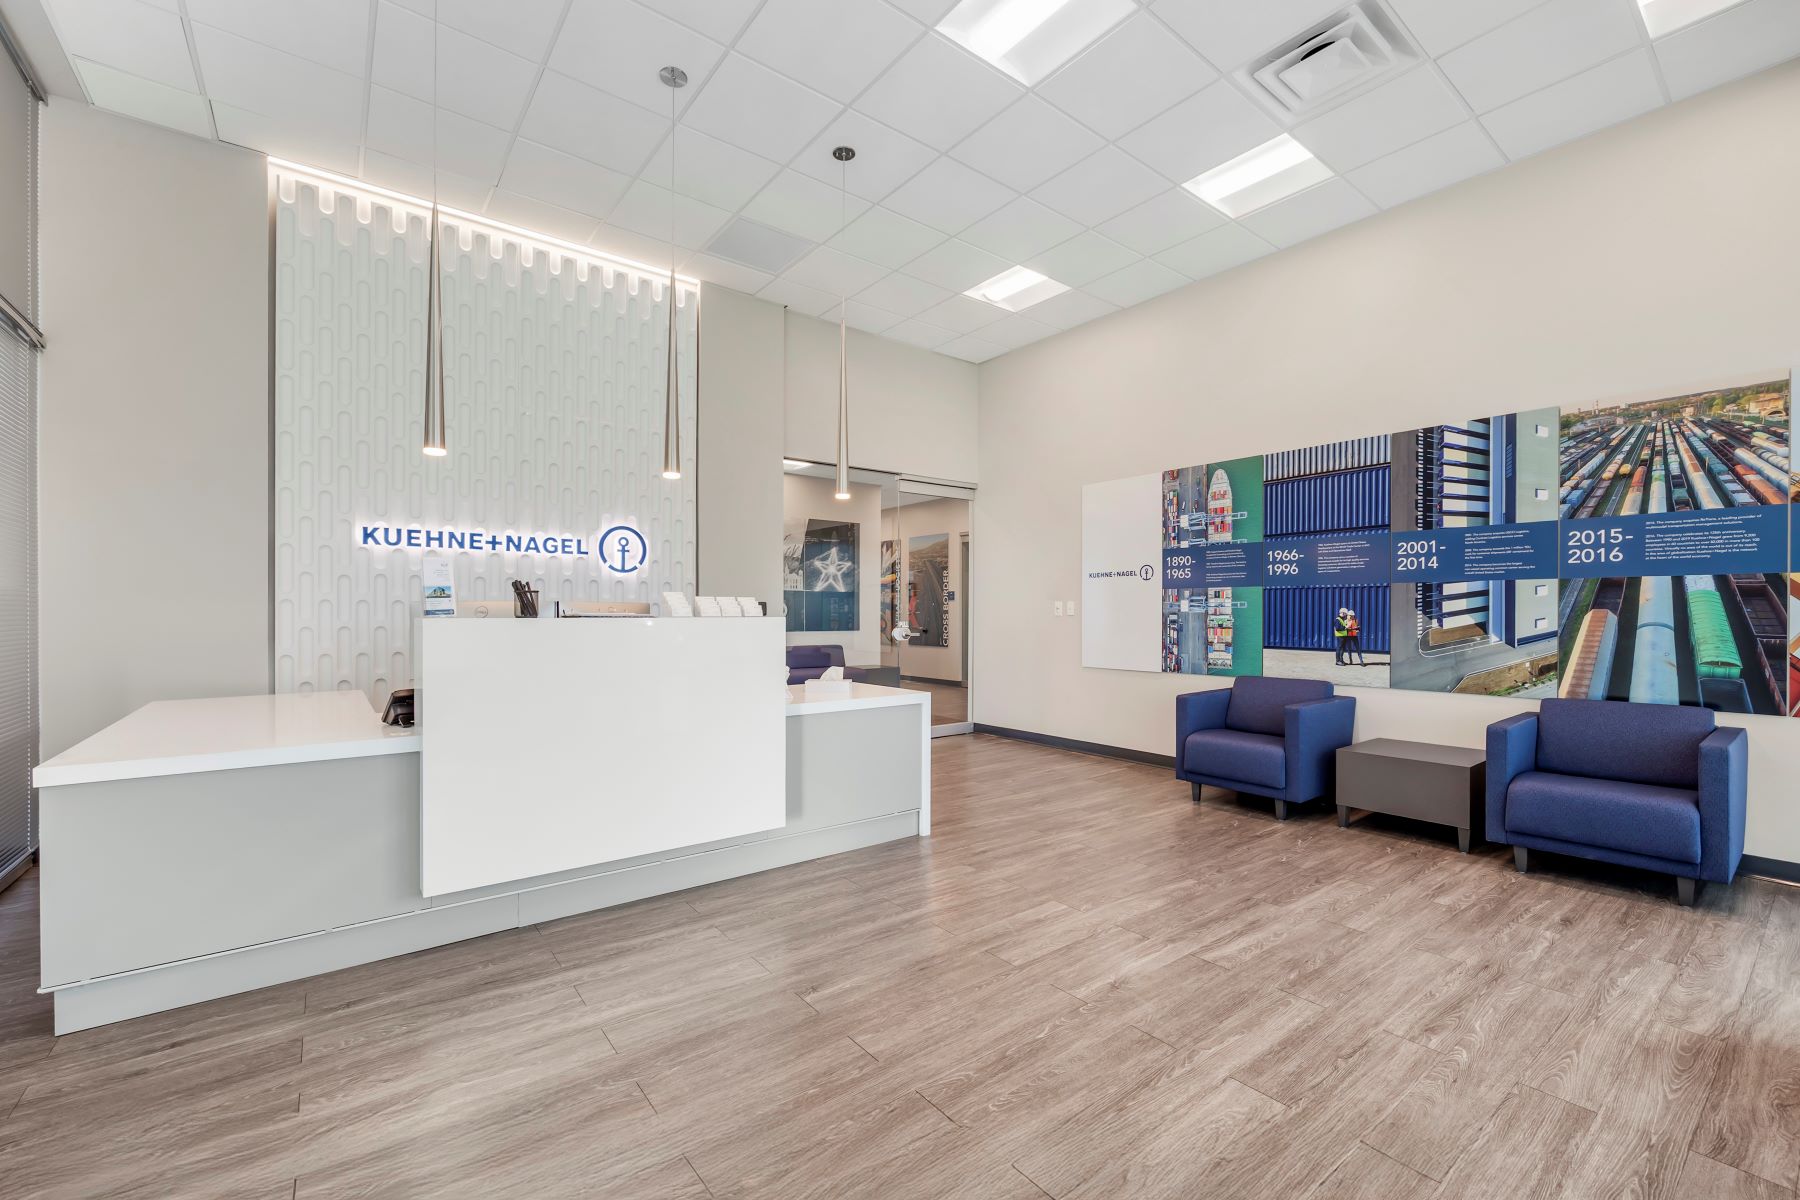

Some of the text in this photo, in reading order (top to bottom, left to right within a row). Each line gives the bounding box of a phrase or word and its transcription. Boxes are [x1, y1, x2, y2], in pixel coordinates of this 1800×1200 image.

[362, 526, 588, 555] KUEHNE+NAGEL
[1568, 528, 1633, 545] 2015-
[1397, 540, 1446, 555] 2001-
[1166, 556, 1196, 567] 1890-
[1267, 549, 1304, 561] 1966-
[1568, 547, 1624, 563] 2016
[1267, 563, 1298, 575] 1996
[1397, 556, 1439, 570] 2014
[1089, 570, 1138, 579] KUEHNE+NAGEL
[1166, 568, 1191, 579] 1965
